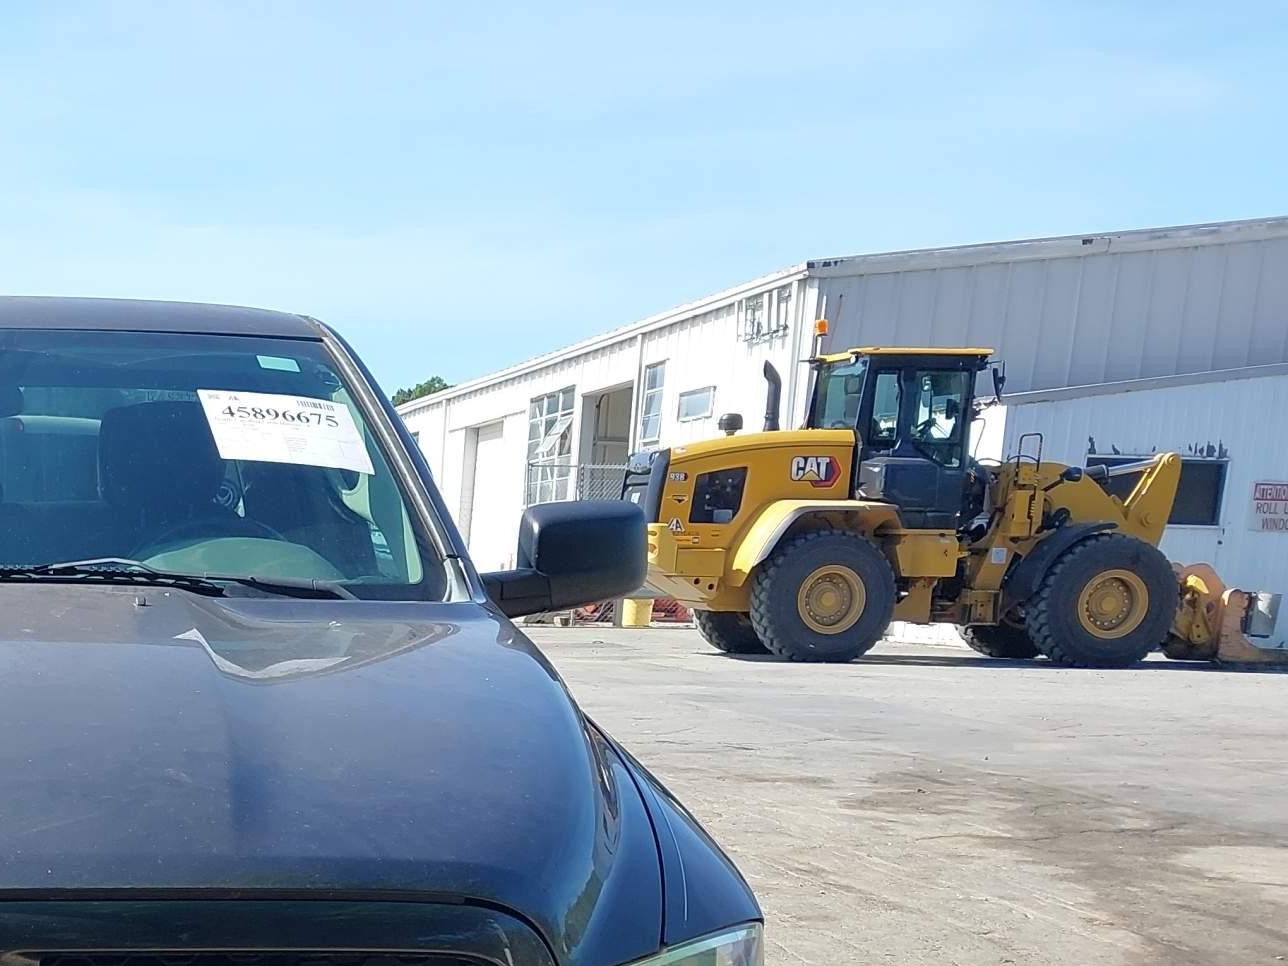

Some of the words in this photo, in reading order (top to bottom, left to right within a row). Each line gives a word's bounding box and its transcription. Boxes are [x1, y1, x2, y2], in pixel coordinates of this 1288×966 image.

[222, 405, 339, 428] 45896675
[792, 456, 830, 481] CAT
[1256, 502, 1280, 515] ROLL
